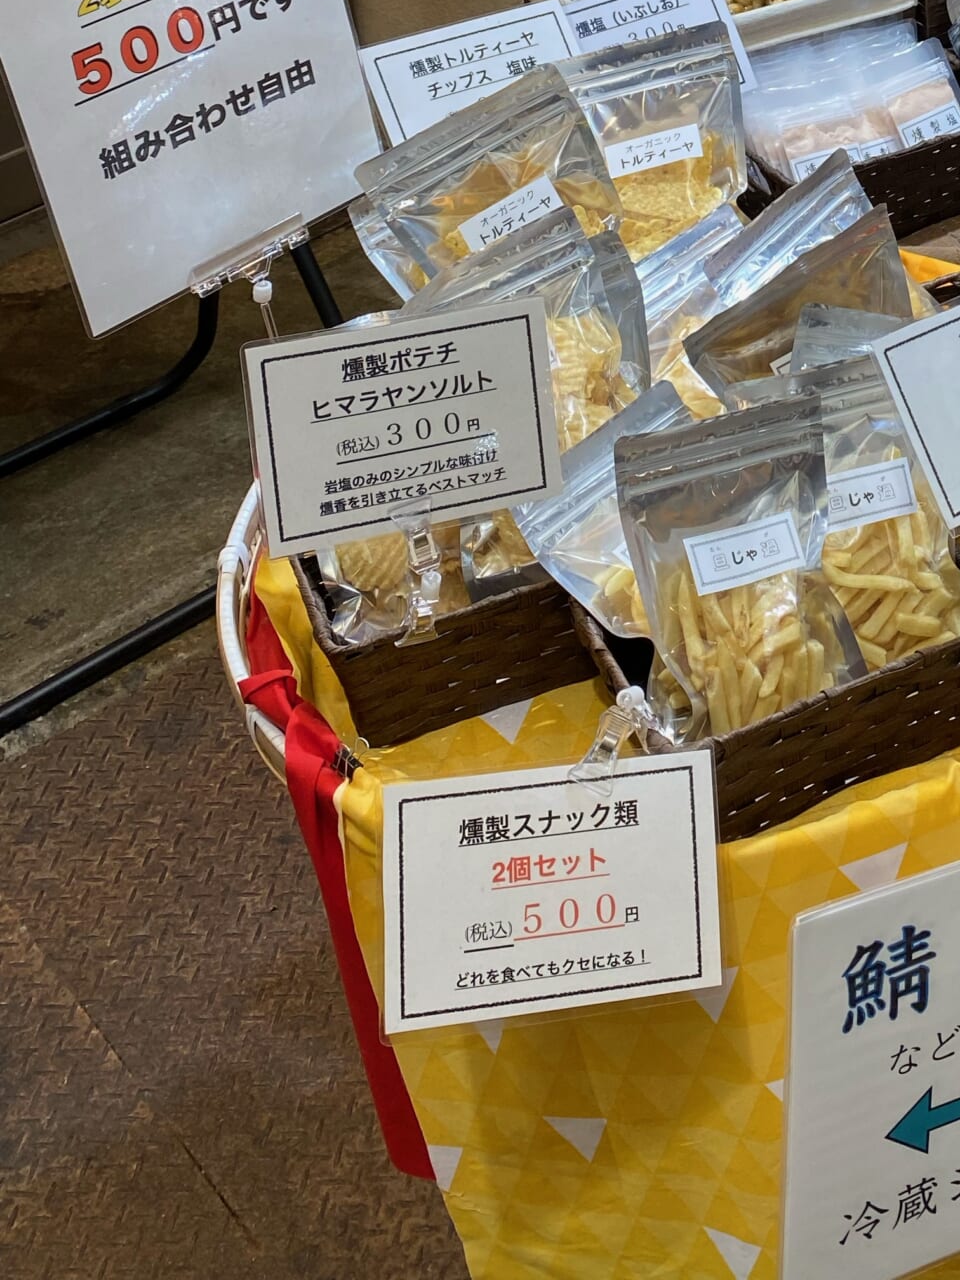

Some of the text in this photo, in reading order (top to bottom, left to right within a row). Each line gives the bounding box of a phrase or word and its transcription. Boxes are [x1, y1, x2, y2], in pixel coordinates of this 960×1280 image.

[409, 30, 535, 78] 燻製トルティーヤ
[427, 70, 492, 99] チップス
[98, 59, 317, 181] 組み合わせ自由
[620, 141, 694, 169] トルティーヤ
[625, 132, 681, 154] オーガニック
[480, 190, 534, 227] オーガニック
[480, 196, 551, 246] トルティーヤ
[341, 341, 457, 380] 燻製ポテチ
[312, 370, 493, 420] ヒマラヤンソルト
[320, 466, 506, 516] 燻香を引き立てるベストマッチ
[325, 449, 497, 495] 岩塩のみのシンプルな味付け
[458, 799, 639, 845] 燻製スナック類
[492, 847, 606, 883] 2個セット
[456, 949, 646, 988] どれを食べてもクセになる！
